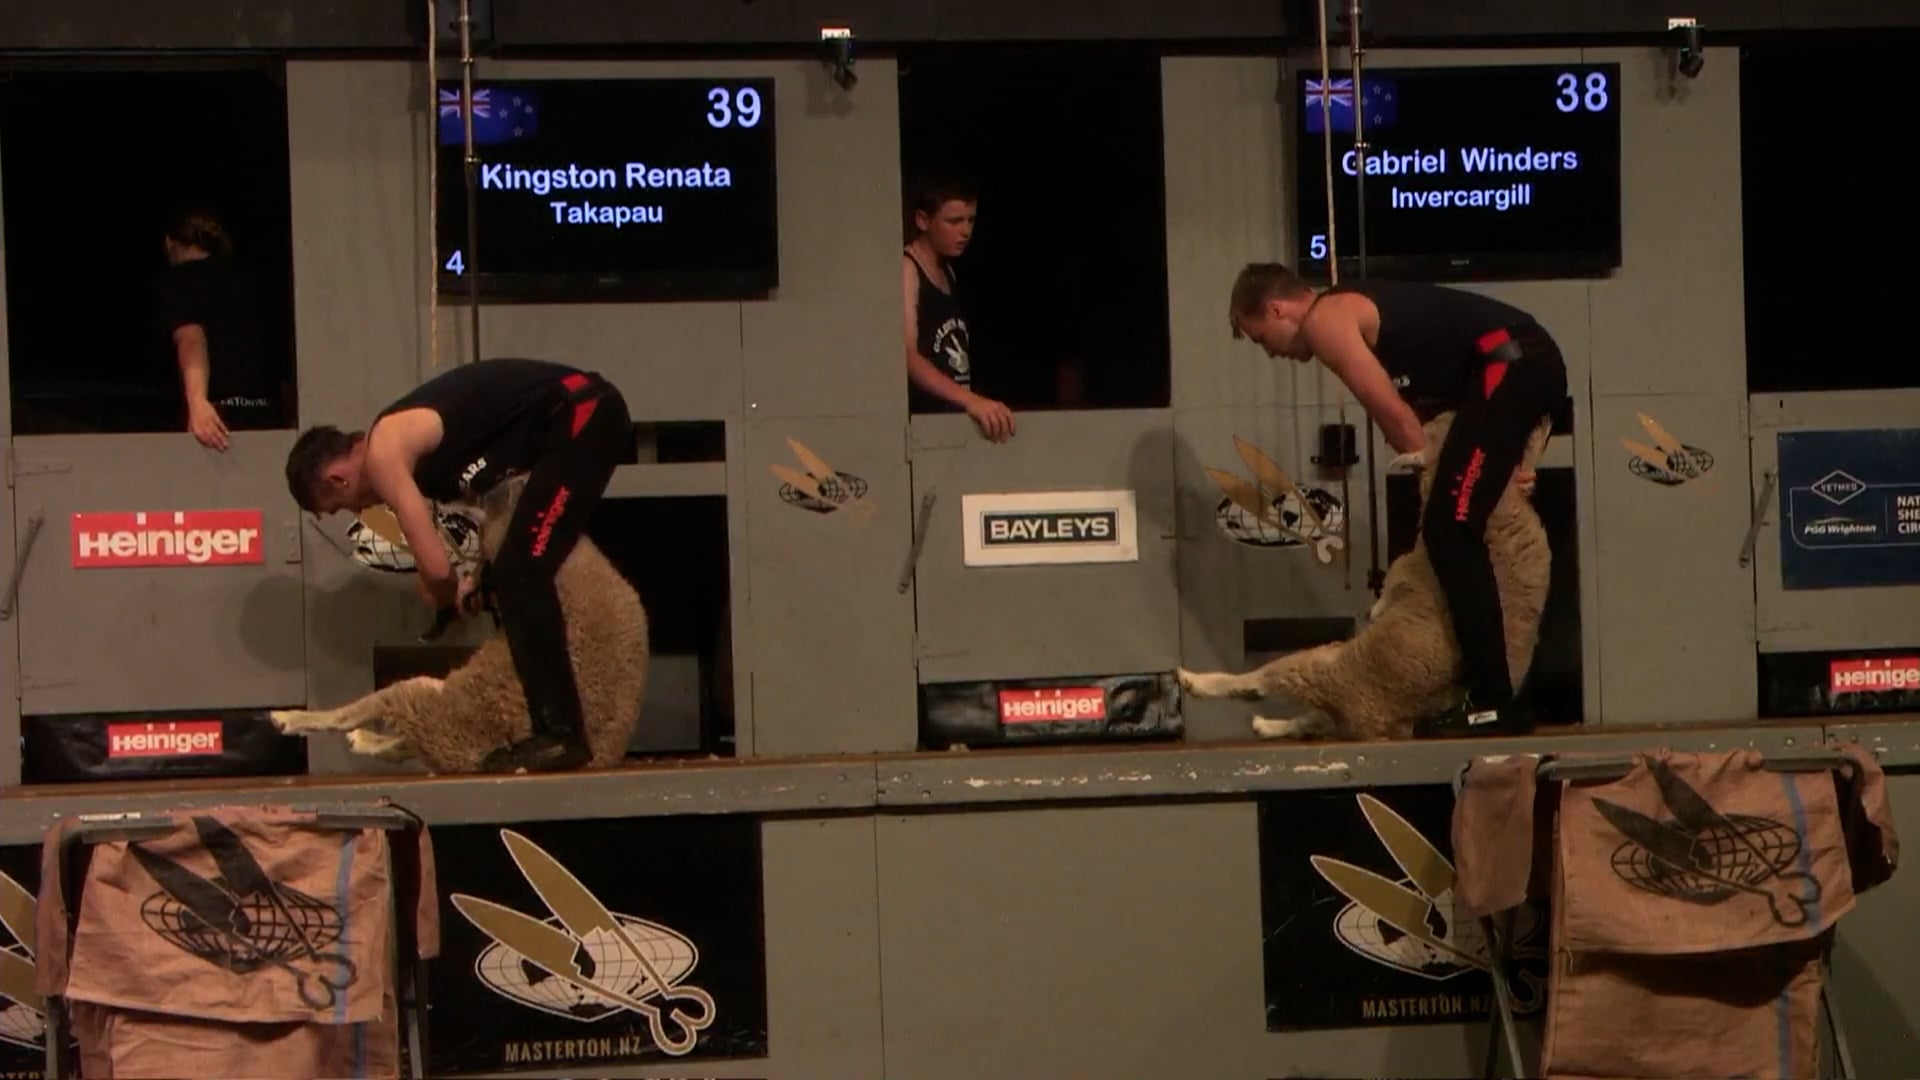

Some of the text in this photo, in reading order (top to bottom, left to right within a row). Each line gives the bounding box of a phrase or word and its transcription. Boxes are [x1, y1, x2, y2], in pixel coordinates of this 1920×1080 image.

[706, 86, 761, 128] 39
[1556, 72, 1609, 112] 38
[1341, 146, 1579, 176] Gabriel Winders
[481, 161, 732, 196] Kingston Renata
[1391, 183, 1531, 211] Invercargill
[550, 201, 664, 229] Takapau
[1309, 234, 1326, 260] 5
[445, 249, 466, 277] 4
[1450, 448, 1487, 521] Heiniger
[531, 485, 571, 558] Heiniger
[990, 517, 1110, 540] BAYLEYS
[79, 511, 258, 563] Heiniger
[1003, 689, 1103, 719] Heiniger
[112, 722, 220, 753] Heiniger
[505, 1035, 641, 1062] MASTERTON.NZ
